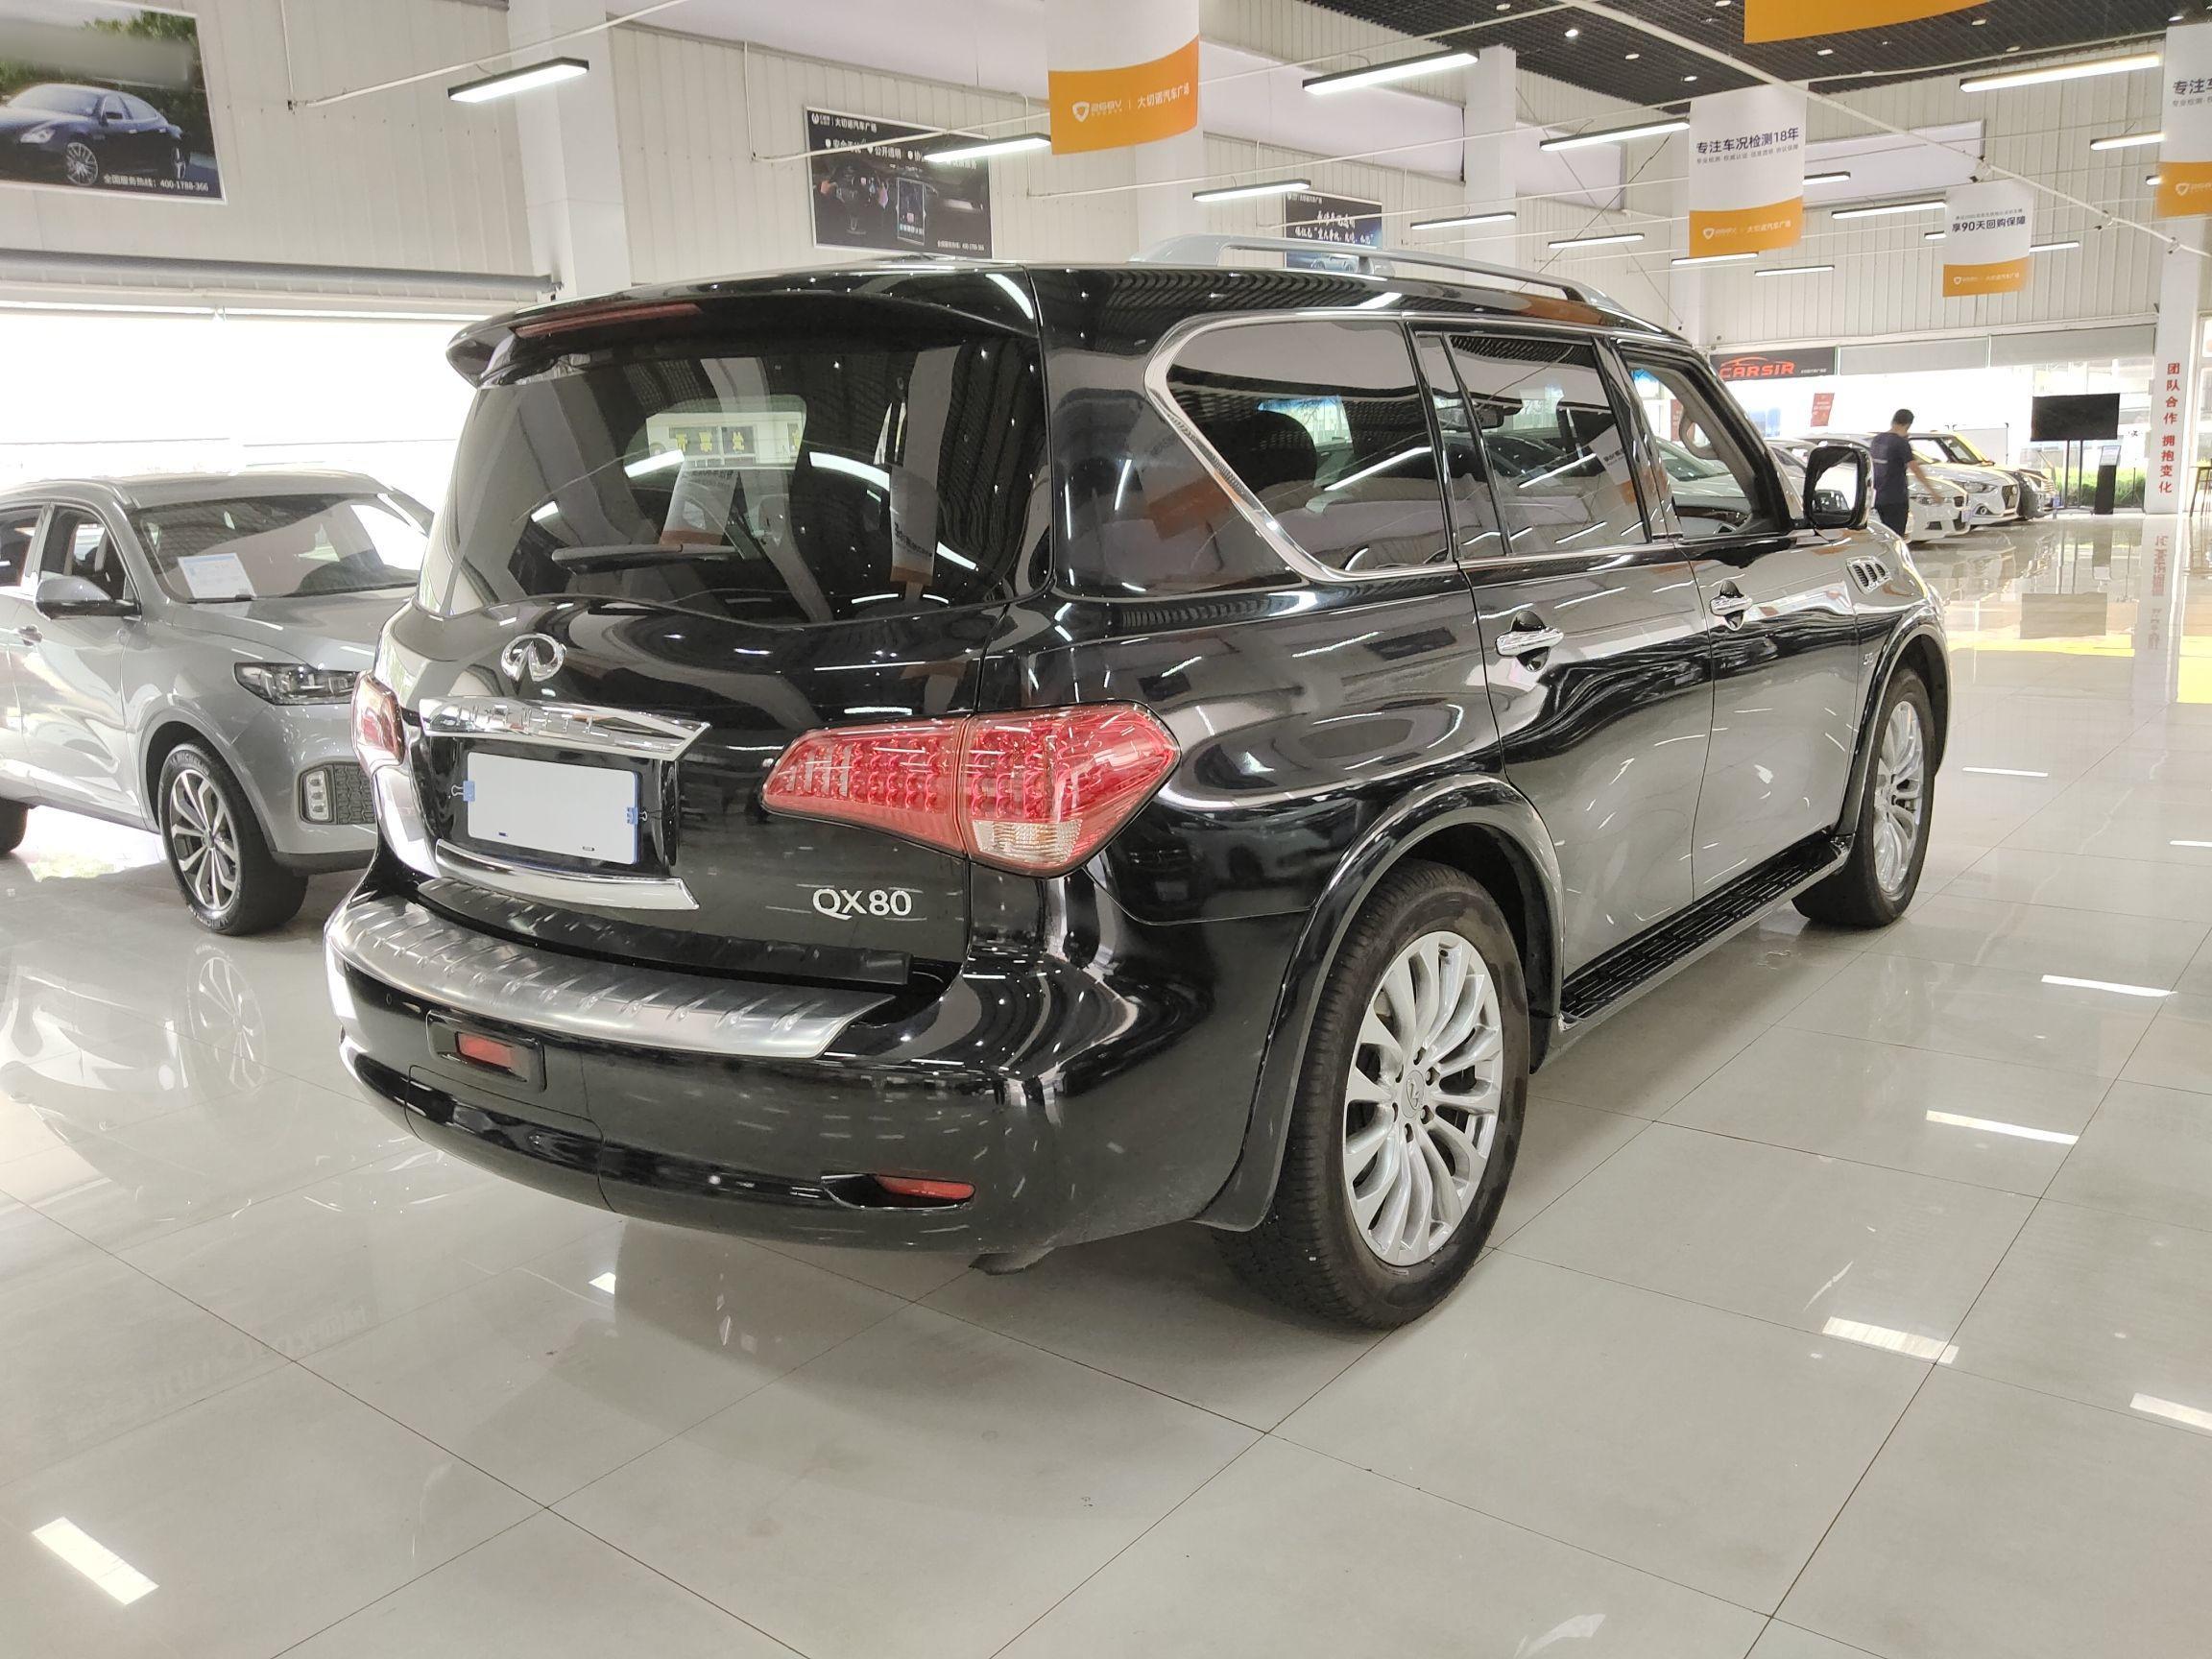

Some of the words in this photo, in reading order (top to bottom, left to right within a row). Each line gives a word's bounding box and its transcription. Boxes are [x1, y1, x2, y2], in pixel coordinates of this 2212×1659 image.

[1696, 127, 1799, 154] 专注车况检测18年
[1952, 216, 2026, 232] 享90天回购保障
[1719, 361, 1796, 378] CARSIR
[2162, 362, 2180, 424] 团队合作
[2158, 435, 2176, 493] 拥抱变化
[812, 888, 912, 921] QX80
